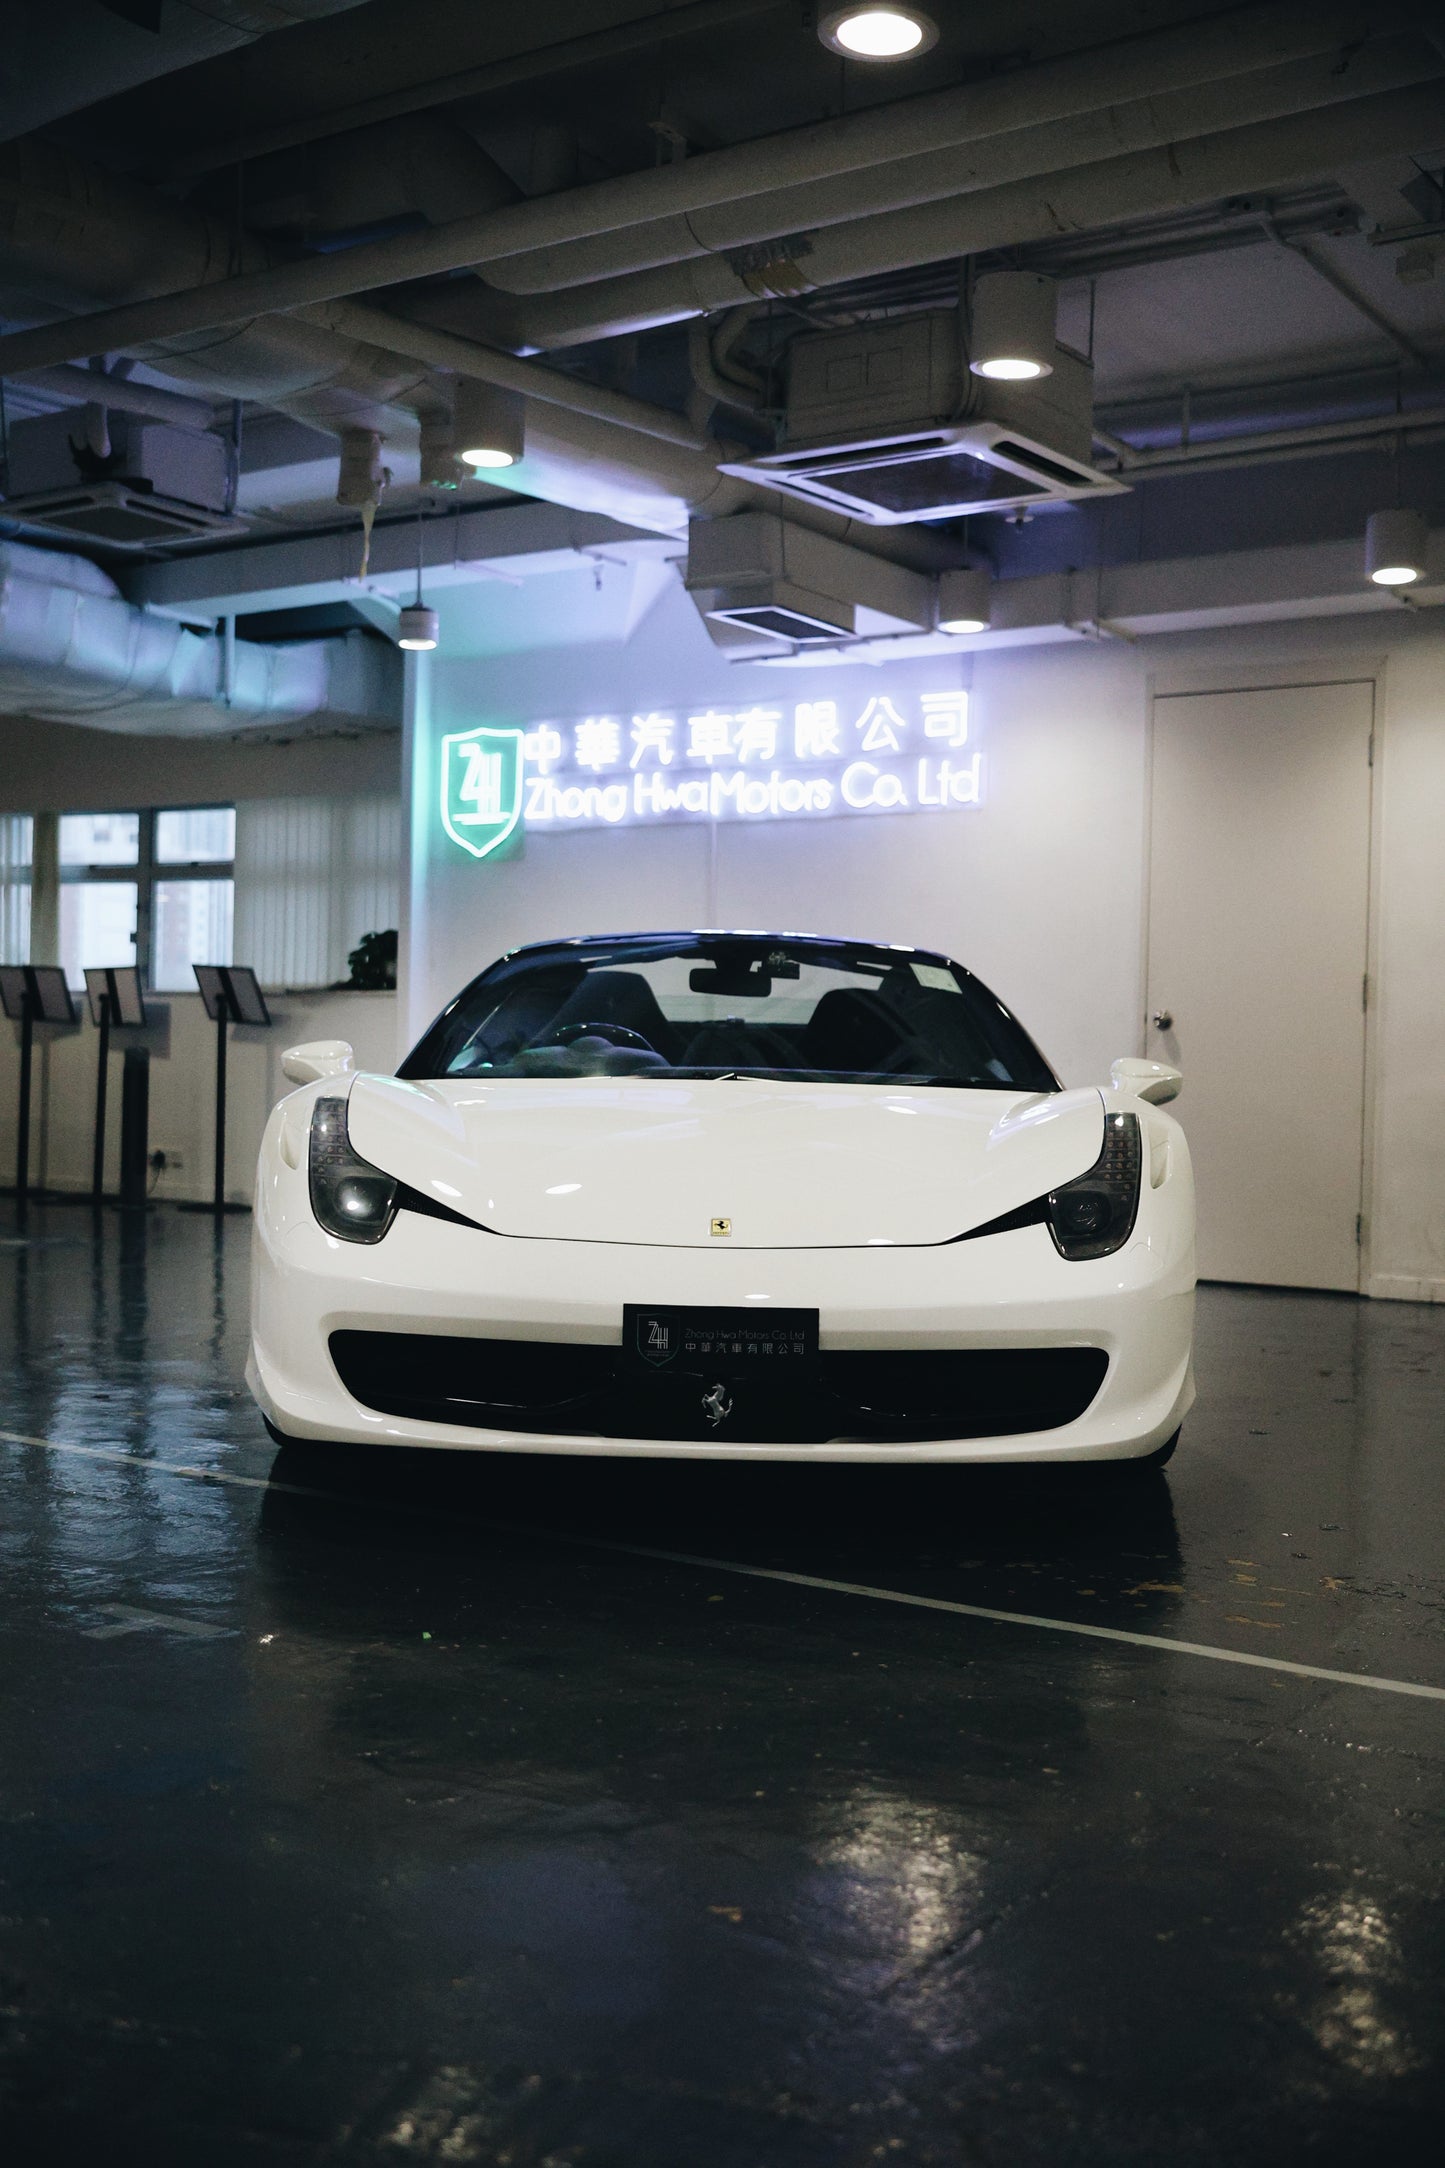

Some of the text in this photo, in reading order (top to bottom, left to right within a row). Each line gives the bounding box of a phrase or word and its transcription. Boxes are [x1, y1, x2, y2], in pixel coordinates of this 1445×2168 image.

[525, 691, 968, 774] 中華汽車有限公司
[525, 776, 627, 822] Zhong
[634, 772, 708, 815] Hwa
[710, 768, 832, 817] Motors
[918, 752, 982, 806] Ltd
[684, 1328, 714, 1340] Zhong
[716, 1329, 737, 1339] Hwa
[738, 1329, 769, 1340] Motors
[685, 1342, 804, 1355] 中華汽車有限公司
